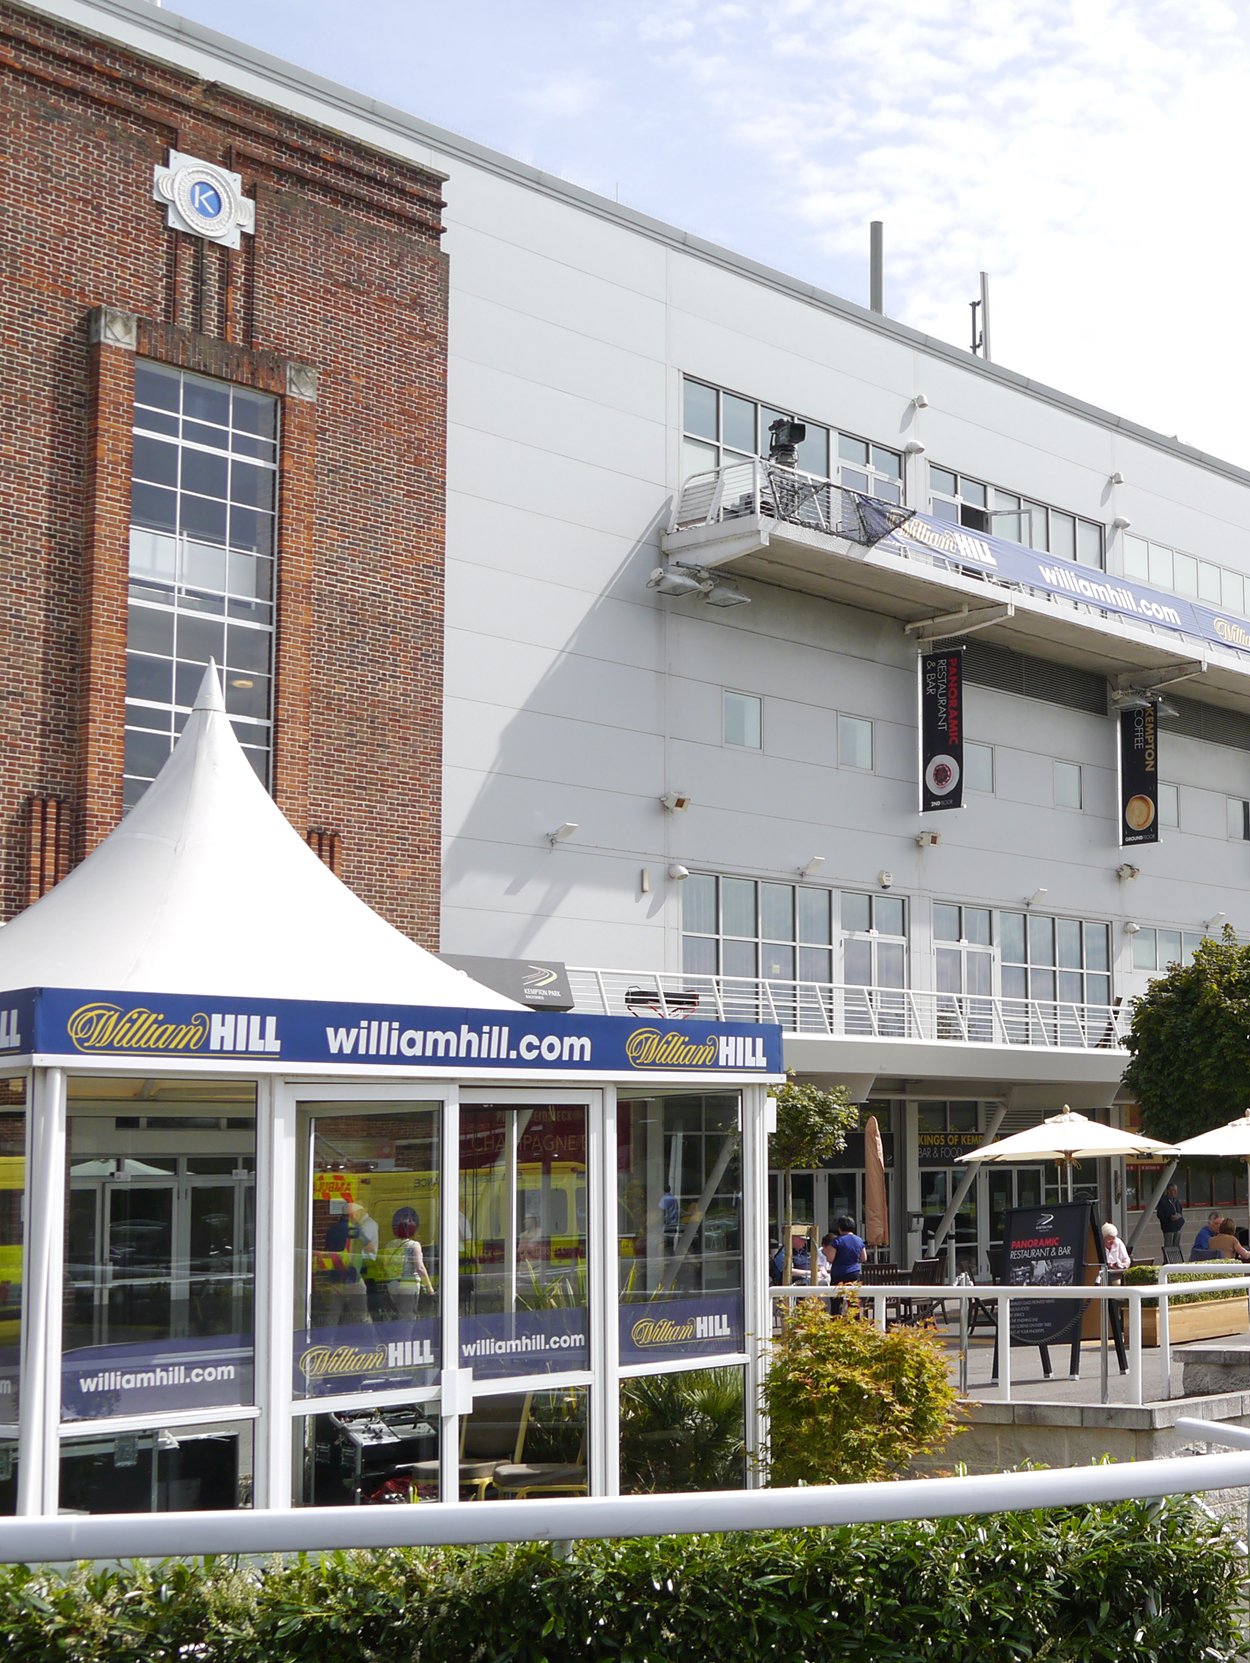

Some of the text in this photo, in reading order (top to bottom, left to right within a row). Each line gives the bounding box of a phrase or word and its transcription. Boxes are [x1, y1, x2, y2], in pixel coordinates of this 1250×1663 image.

[194, 185, 215, 214] K
[954, 532, 998, 566] HILL
[1038, 565, 1182, 626] williamhill.com
[926, 660, 937, 695] & BAR
[937, 659, 948, 731] RESTAURANT
[948, 658, 959, 745] PANORAMIC
[1134, 708, 1144, 750] COFFEE
[1145, 707, 1155, 772] KEMPTON
[1125, 835, 1144, 843] GROUND
[67, 1002, 281, 1052] William HILL
[325, 1020, 592, 1062] williamhill.com
[626, 1027, 767, 1068] William HILL
[471, 1134, 577, 1151] CHAPAGNE
[918, 1134, 1000, 1146] KINGS OF KEMPN
[918, 1147, 962, 1158] BAR & FOOD
[1010, 1245, 1072, 1260] RESTAURANT & BAR
[1011, 1236, 1060, 1250] PANORAMIC
[462, 1333, 585, 1357] williamhill.com
[631, 1314, 731, 1345] William HILL
[300, 1339, 434, 1377] William HILL
[79, 1364, 235, 1394] williamhill.com
